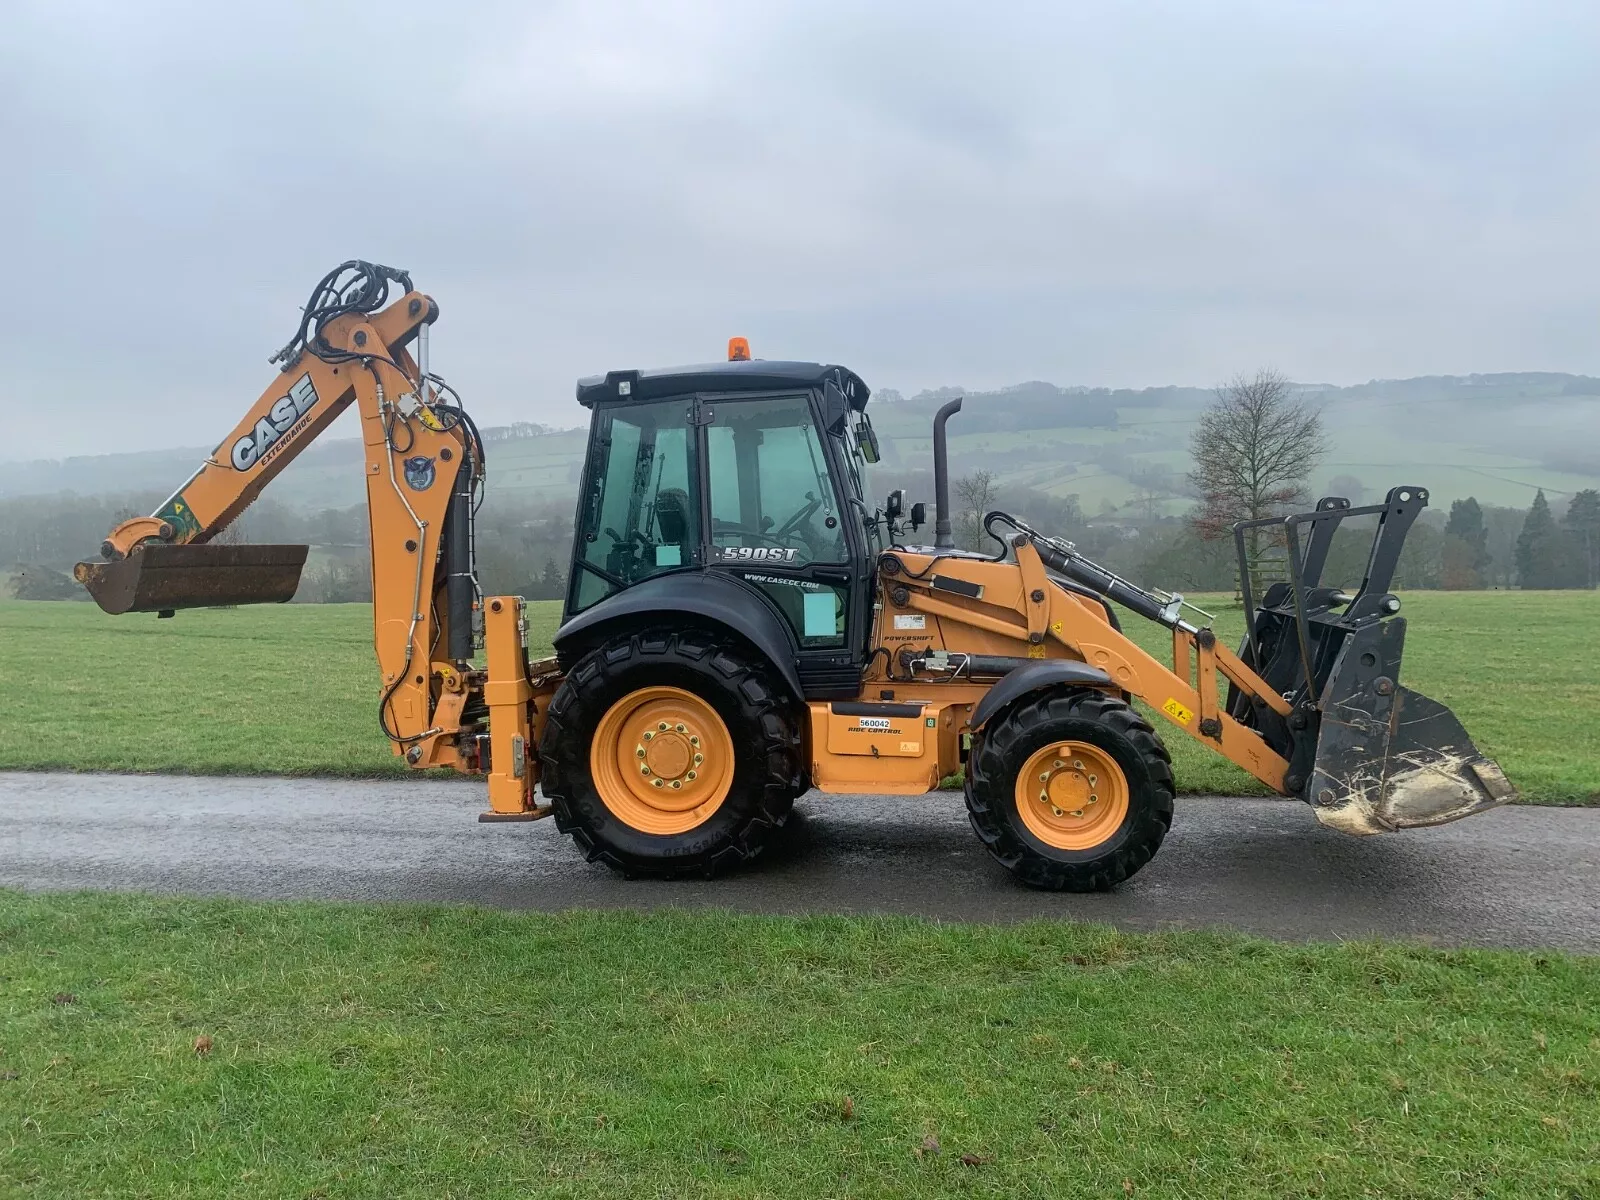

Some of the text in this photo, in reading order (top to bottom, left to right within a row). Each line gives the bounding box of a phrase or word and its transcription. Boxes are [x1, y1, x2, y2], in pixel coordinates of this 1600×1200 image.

[231, 372, 319, 471] CASE
[261, 413, 313, 466] EXTENDAHOE
[723, 547, 799, 563] 590ST
[744, 573, 820, 589] WWW.CASECE.COM
[860, 719, 890, 728] 560042
